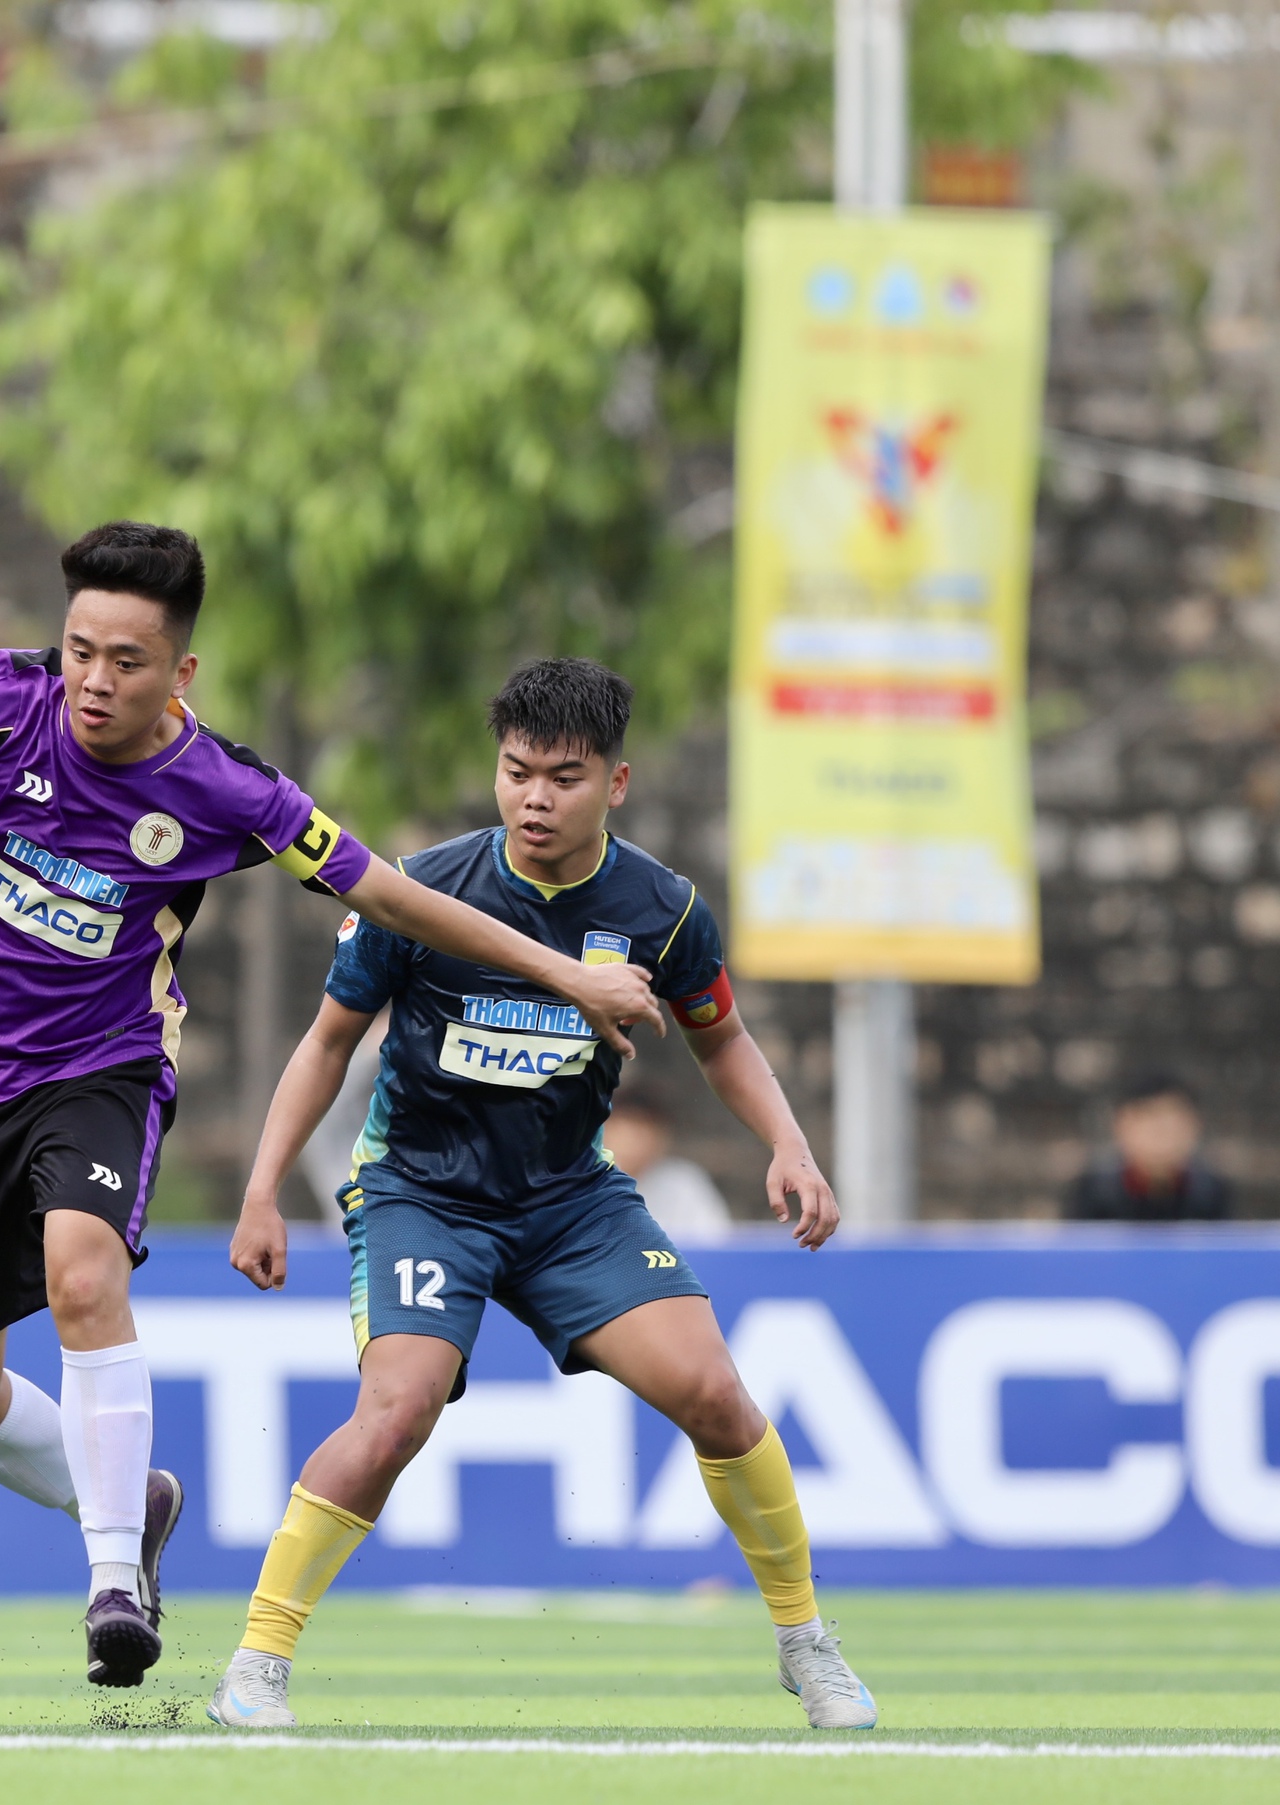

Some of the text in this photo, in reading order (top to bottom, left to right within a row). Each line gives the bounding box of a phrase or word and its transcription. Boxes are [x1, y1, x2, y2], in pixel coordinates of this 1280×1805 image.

[292, 818, 331, 862] C
[3, 829, 79, 889] THANH
[69, 863, 130, 908] NIÊN
[593, 941, 620, 950] University
[594, 935, 622, 944] HUTECH
[462, 995, 540, 1030] THANH
[394, 1257, 446, 1311] 12
